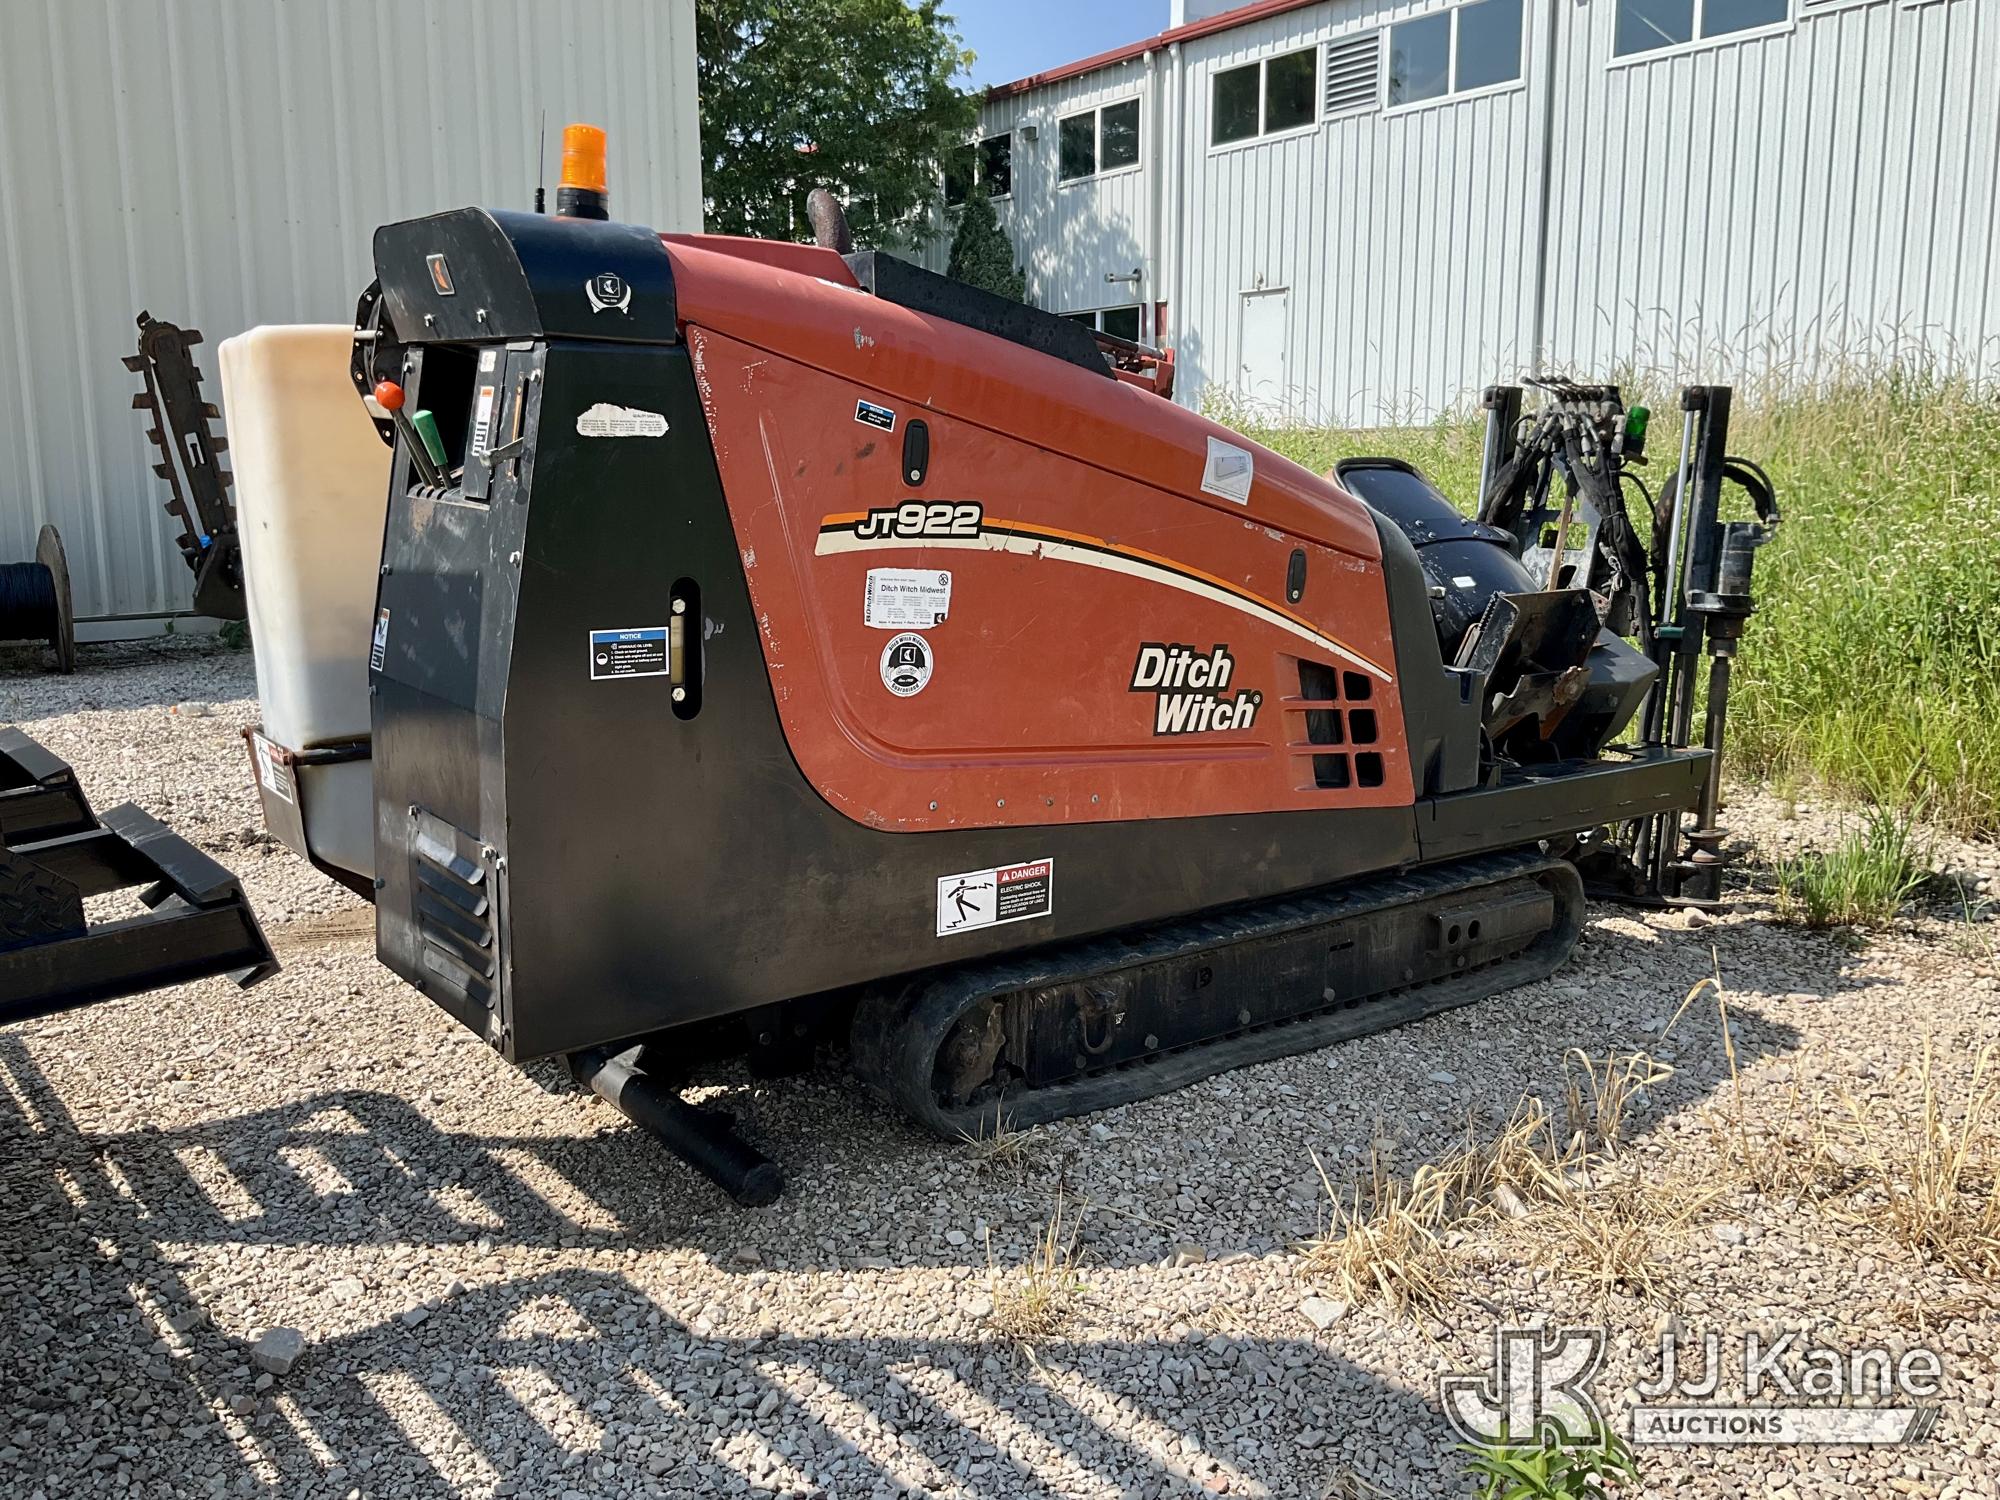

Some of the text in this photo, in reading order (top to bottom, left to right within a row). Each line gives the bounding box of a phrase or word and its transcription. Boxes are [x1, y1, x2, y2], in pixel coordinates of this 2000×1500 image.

[857, 504, 981, 536] JT922
[881, 584, 946, 594] Ditch Witch Midwest
[1133, 648, 1232, 688] Ditch
[1011, 866, 1046, 880] DANGER
[1000, 884, 1024, 893] ELECTRIC
